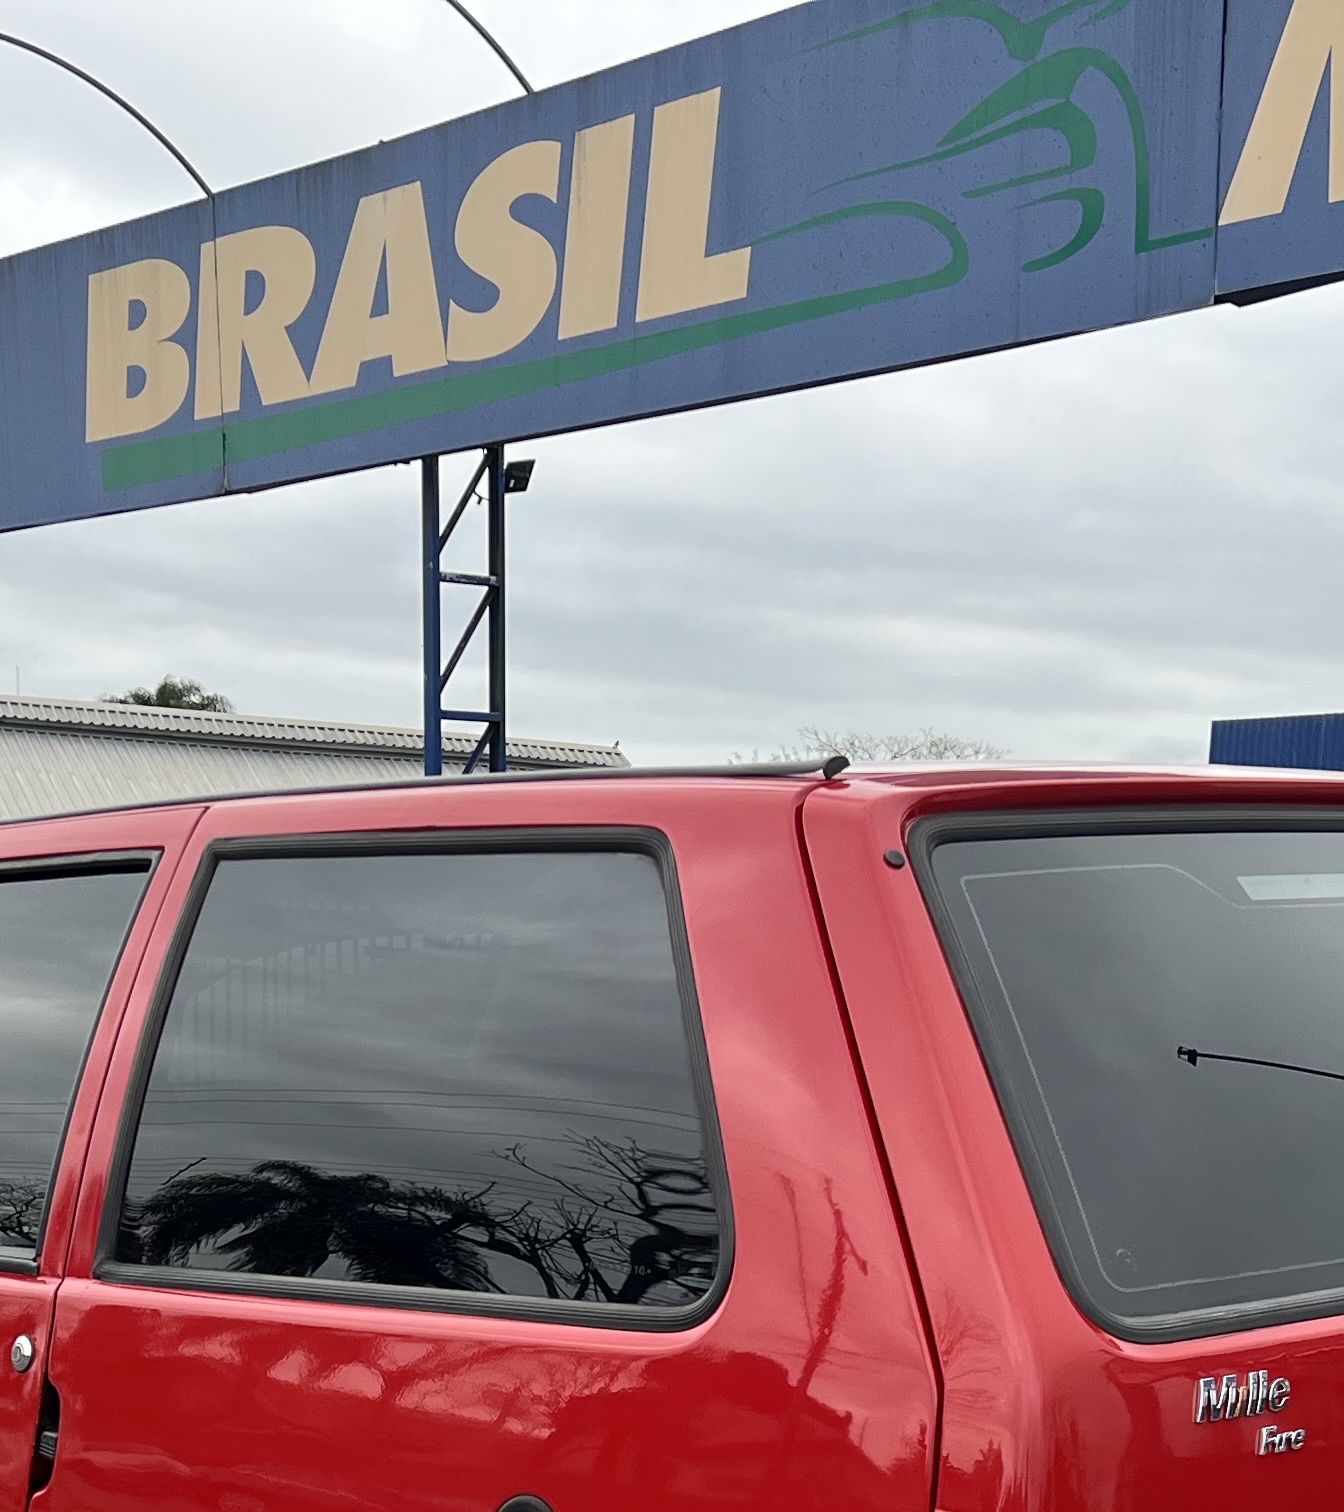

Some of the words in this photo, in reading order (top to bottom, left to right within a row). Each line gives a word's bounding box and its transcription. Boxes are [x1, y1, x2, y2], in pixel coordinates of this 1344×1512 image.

[85, 86, 752, 443] BRASIL
[1194, 1370, 1291, 1423] Mille
[1257, 1425, 1305, 1455] Fire
